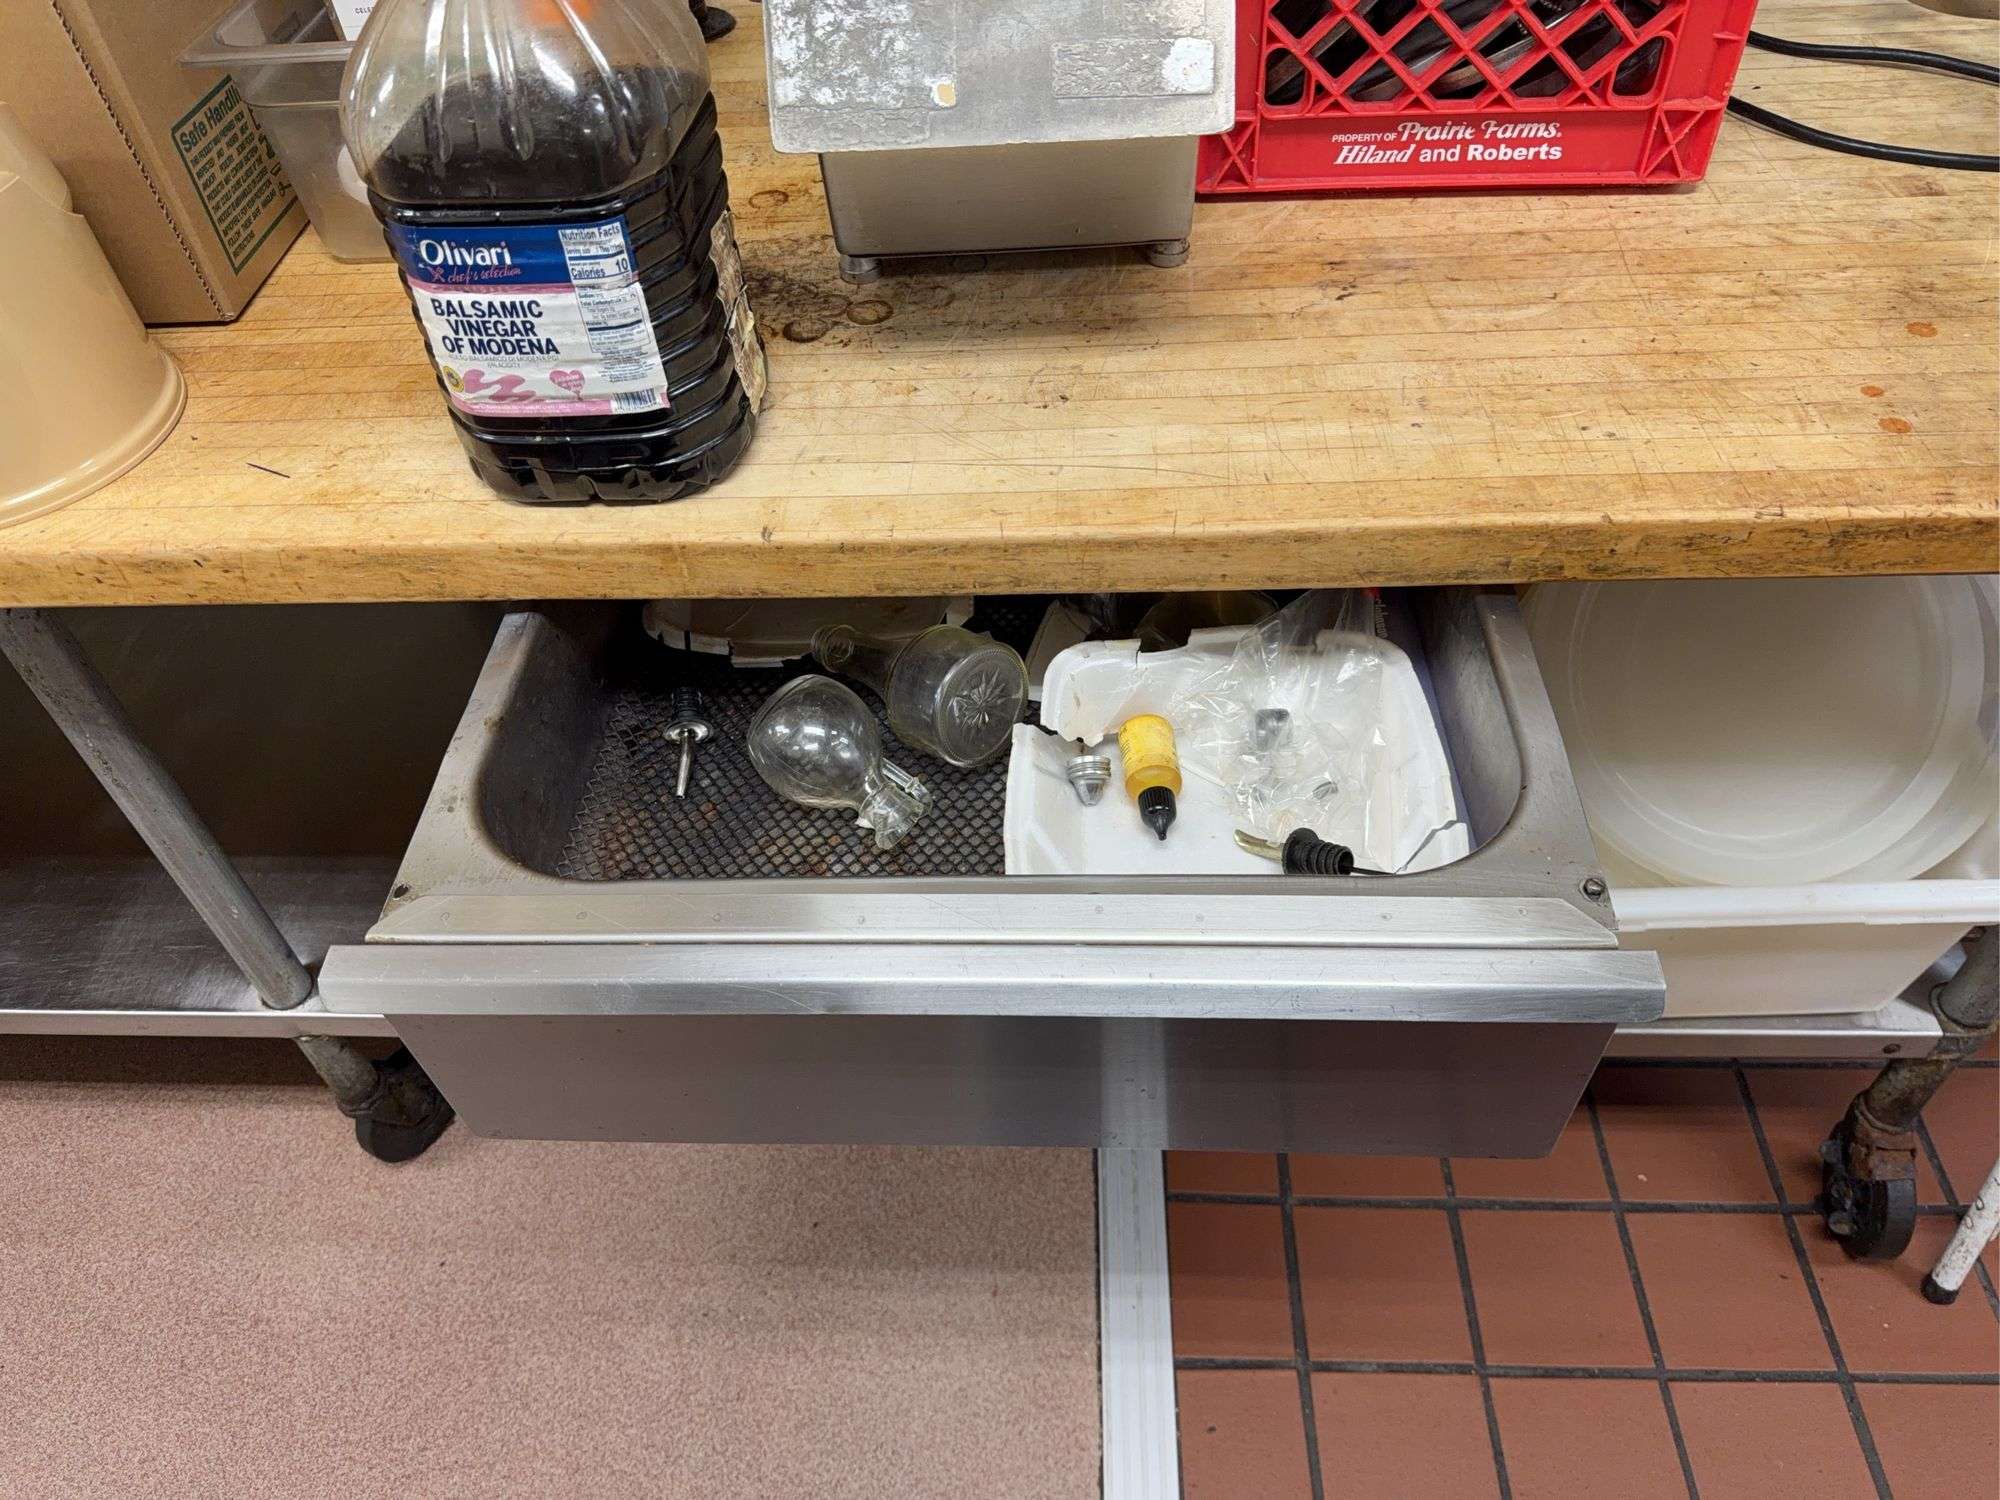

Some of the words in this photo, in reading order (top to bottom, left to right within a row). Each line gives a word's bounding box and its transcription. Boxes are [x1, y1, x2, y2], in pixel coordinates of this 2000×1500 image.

[180, 121, 208, 153] Safe
[204, 86, 242, 128] Handli
[1332, 133, 1382, 142] PROPERTY
[1384, 132, 1397, 141] OF
[1397, 122, 1475, 141] Prairie
[1334, 144, 1415, 165] Hiland
[1419, 144, 1459, 162] and
[1467, 144, 1562, 161] Roberts
[561, 230, 597, 240] Nutrition
[598, 224, 620, 238] Facts
[420, 239, 512, 265] Olivari
[448, 266, 477, 284] chef's
[481, 264, 522, 279] selection
[571, 268, 606, 278] Calories
[616, 257, 628, 272] 10
[432, 298, 543, 318] BALSAMIC
[446, 320, 536, 337] VINEGAR
[442, 336, 466, 354] OF
[469, 337, 560, 356] MODENA
